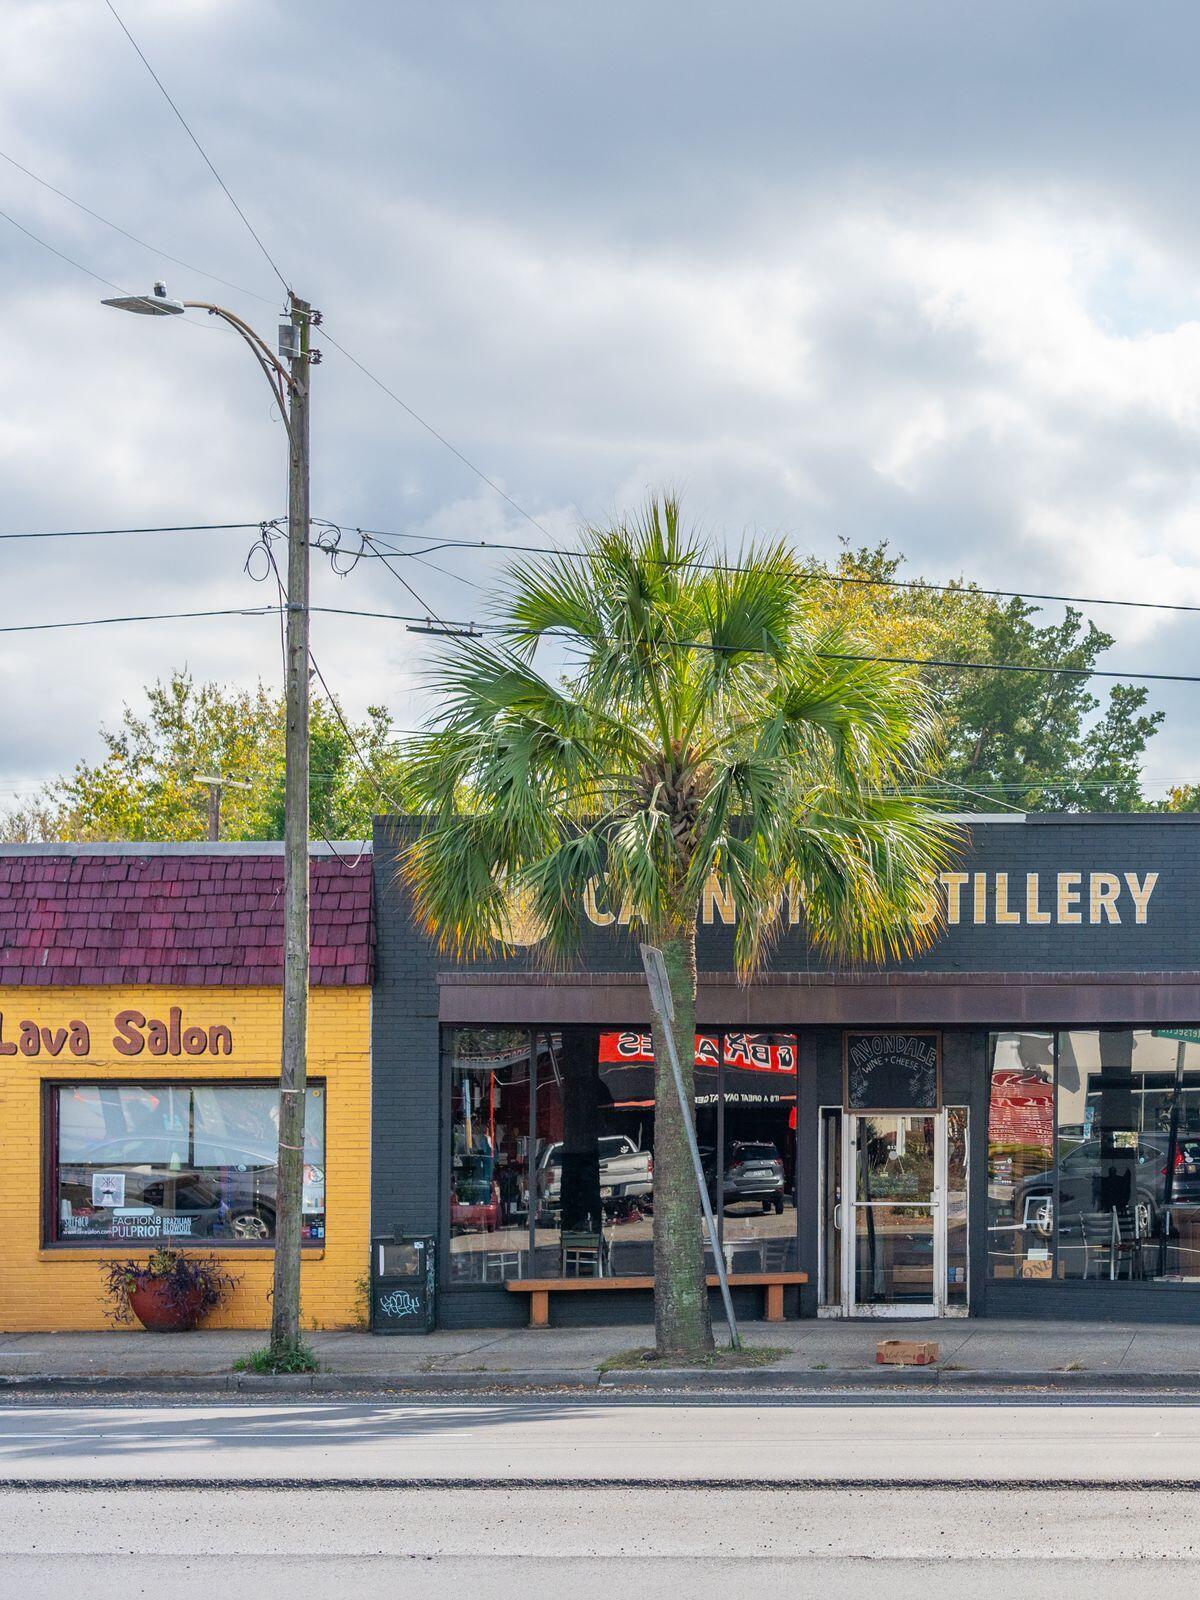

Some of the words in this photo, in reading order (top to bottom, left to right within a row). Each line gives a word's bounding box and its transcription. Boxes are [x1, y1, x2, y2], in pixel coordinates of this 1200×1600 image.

[0, 1011, 90, 1056] Lava
[112, 1006, 232, 1056] Salon
[850, 1036, 936, 1067] AVONDALE
[862, 1056, 884, 1073] WINE
[890, 1056, 918, 1071] CHEESE
[112, 1216, 161, 1226] FACTION8
[162, 1217, 192, 1226] BRAZILIAN
[162, 1224, 191, 1232] BLOWOUT
